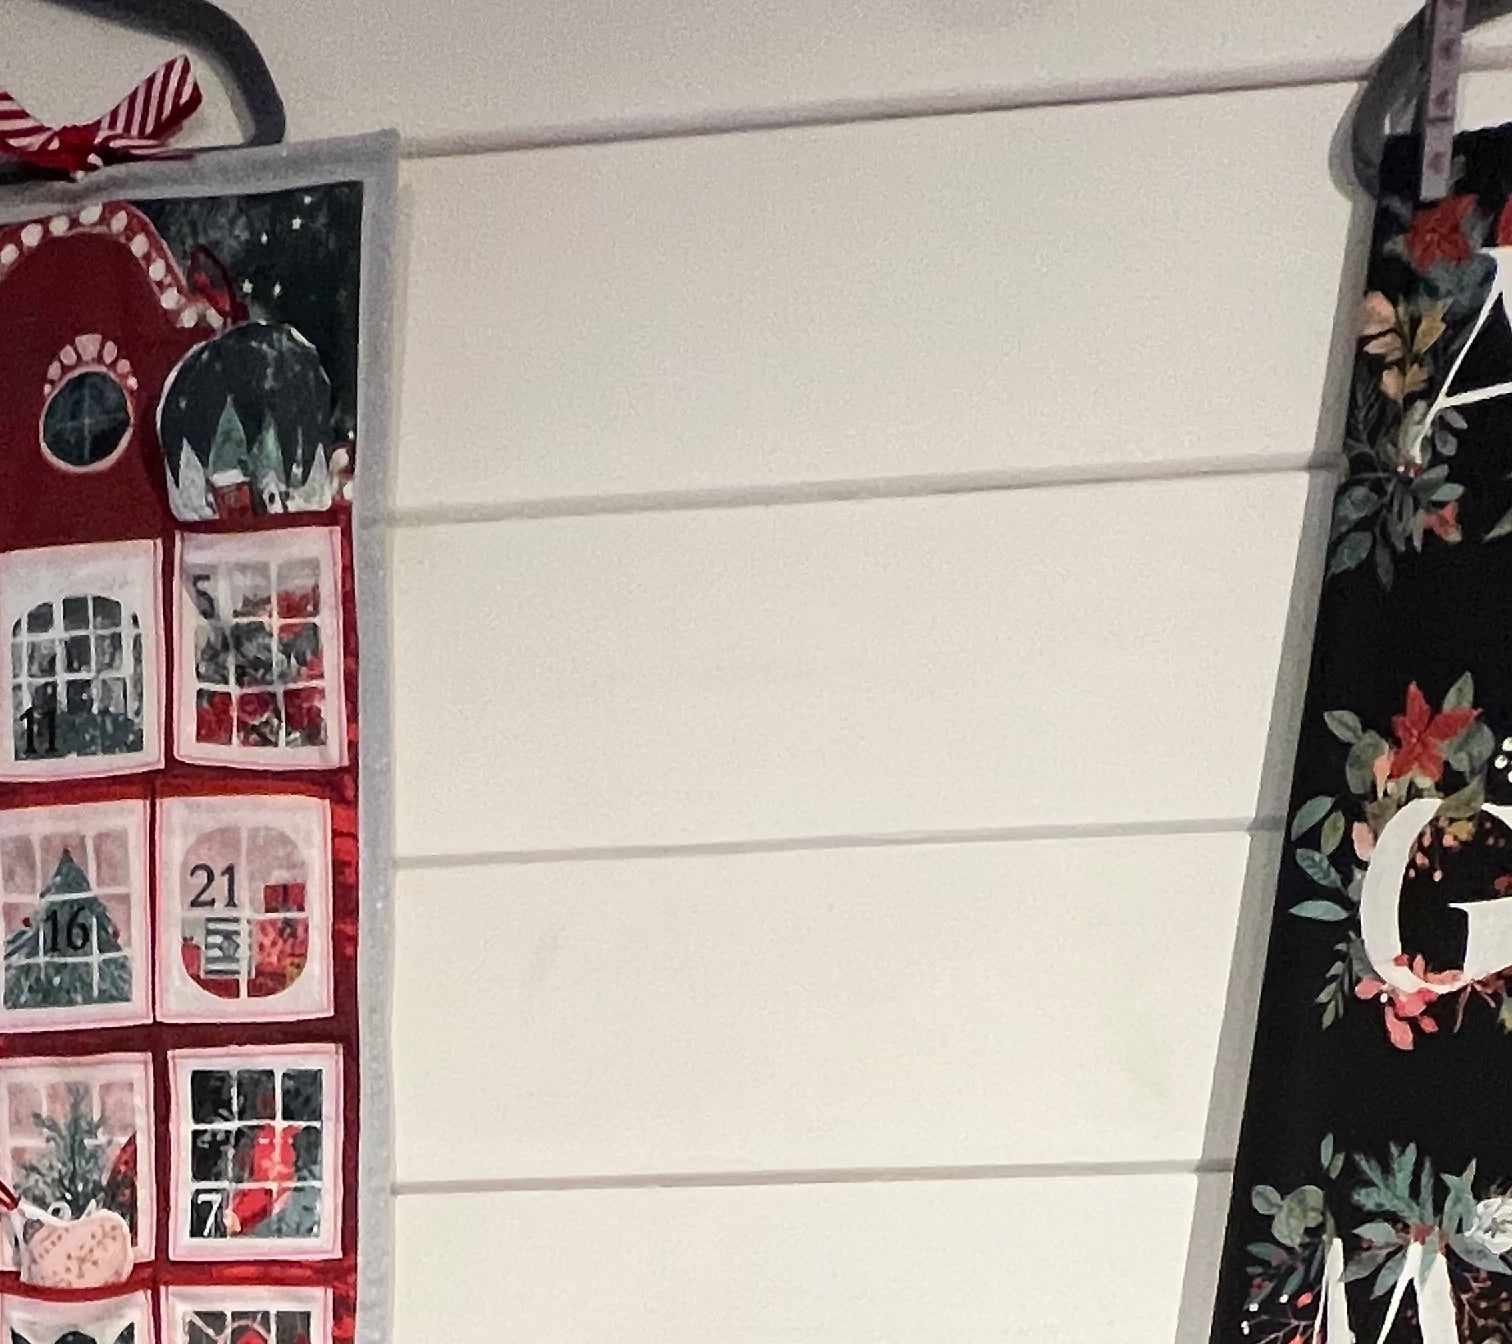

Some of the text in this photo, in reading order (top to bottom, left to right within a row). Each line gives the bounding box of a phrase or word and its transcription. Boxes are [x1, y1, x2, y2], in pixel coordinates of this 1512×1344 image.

[19, 705, 58, 755] 11
[189, 862, 240, 909] 21
[43, 908, 90, 953] 16
[195, 1193, 223, 1237] 7
